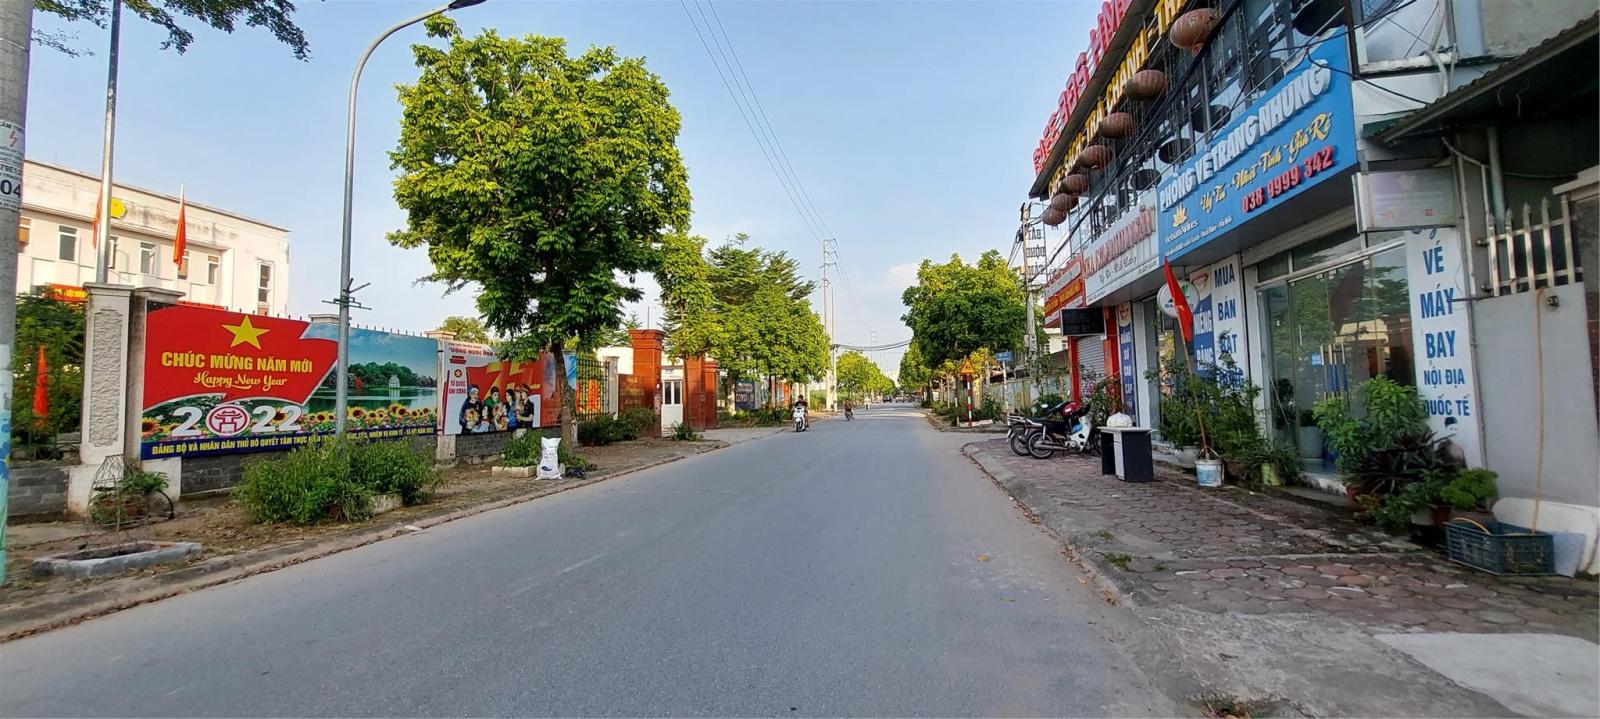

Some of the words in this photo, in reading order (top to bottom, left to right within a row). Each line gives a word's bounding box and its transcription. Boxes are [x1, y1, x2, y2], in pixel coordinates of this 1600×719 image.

[1211, 115, 1260, 173] TRANG
[1258, 58, 1332, 138] NHUNG
[1242, 188, 1264, 213] 038
[1267, 165, 1300, 200] 9999
[1303, 146, 1335, 178] 342
[1422, 239, 1444, 275] VÉ
[1214, 264, 1235, 288] MUA
[1218, 295, 1237, 321] BÁN
[1420, 282, 1454, 319] MÁY
[1425, 330, 1456, 359] BAY
[161, 350, 205, 368] CHÚC
[210, 353, 253, 371] MỪNG
[256, 356, 287, 372] NĂM
[290, 358, 313, 374] MỚI
[194, 371, 233, 389] Happy
[231, 373, 261, 390] New
[263, 375, 288, 392] Year
[1423, 367, 1442, 389] NỘI
[1444, 367, 1466, 389] ĐỊA
[1455, 394, 1470, 416] TẾ
[152, 443, 175, 455] ĐẢNG
[176, 443, 187, 454] BỘ
[188, 441, 198, 451] VÀ
[200, 440, 220, 451] NHÂN
[221, 439, 236, 449] DÂN
[237, 437, 249, 448] THỦ
[250, 438, 259, 447] ĐÔ
[261, 437, 279, 446] QUYẾT
